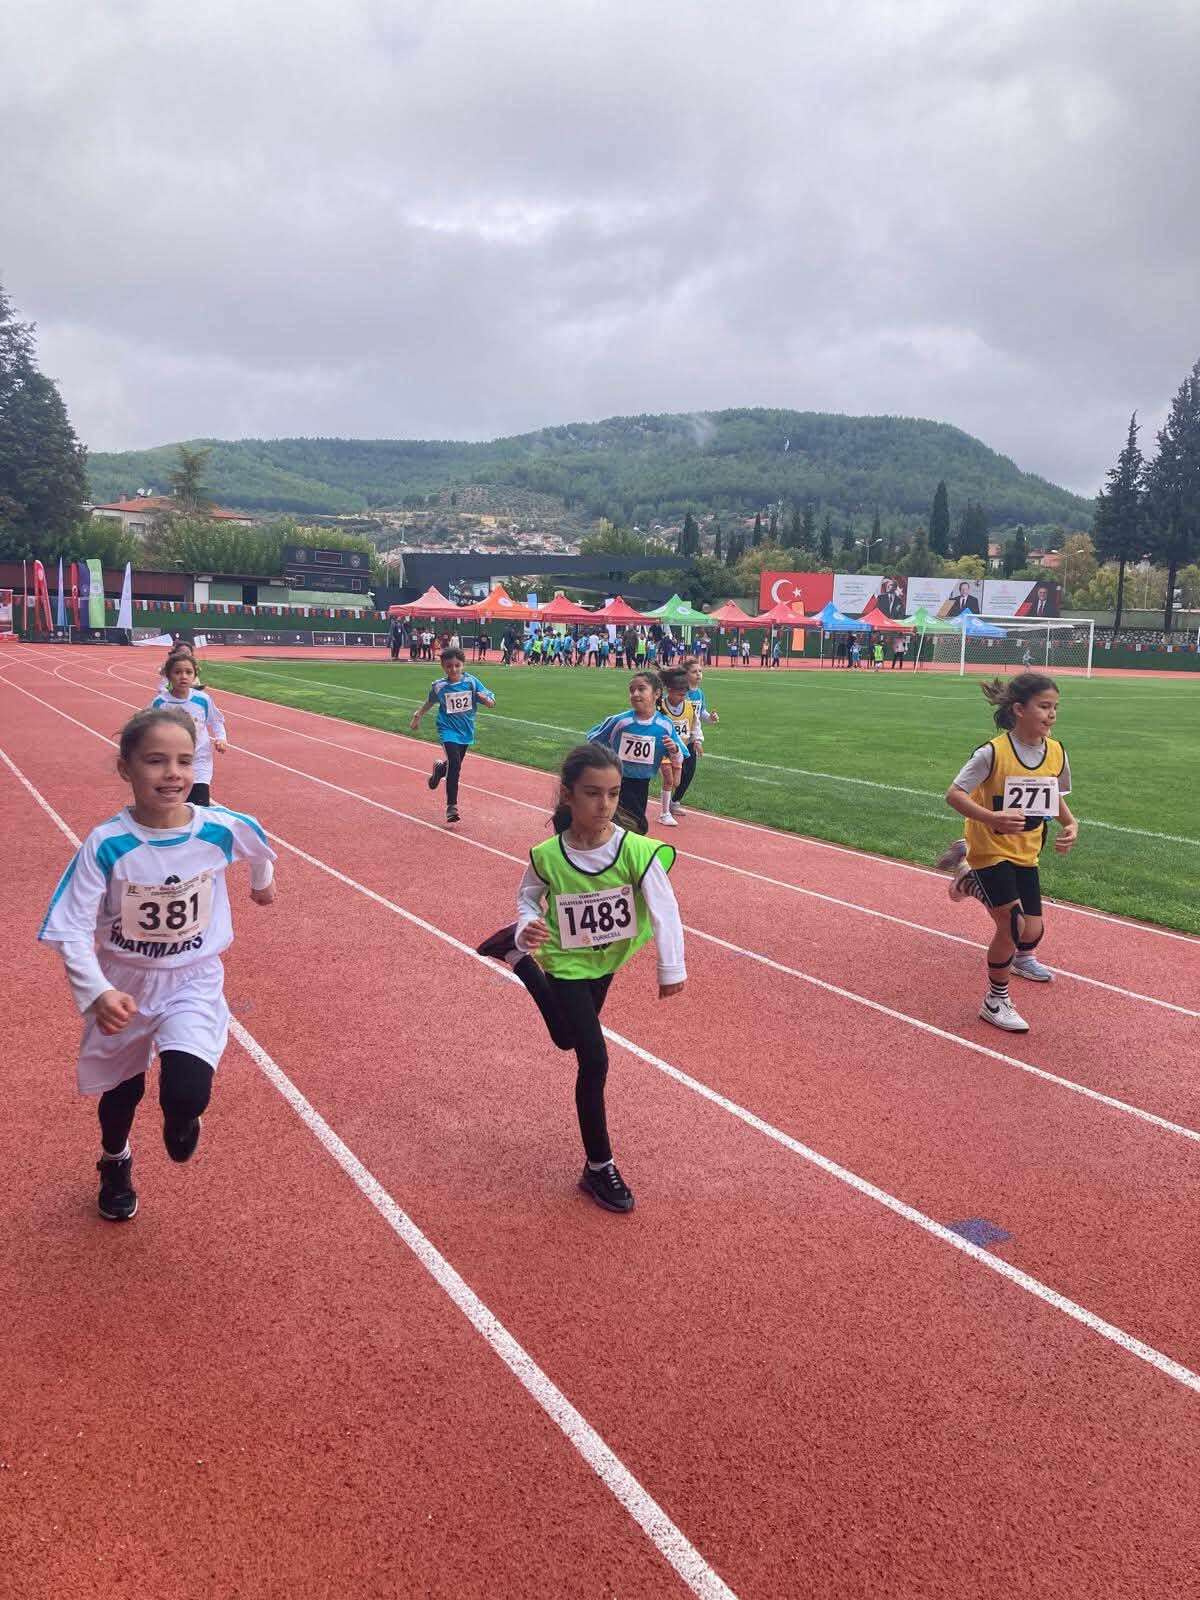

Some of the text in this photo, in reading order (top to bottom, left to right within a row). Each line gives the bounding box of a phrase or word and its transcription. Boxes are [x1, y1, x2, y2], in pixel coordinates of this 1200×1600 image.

[450, 697, 469, 710] 182
[624, 739, 651, 758] 780
[1007, 786, 1051, 809] 271
[138, 892, 199, 930] 381
[564, 898, 632, 936] 1483
